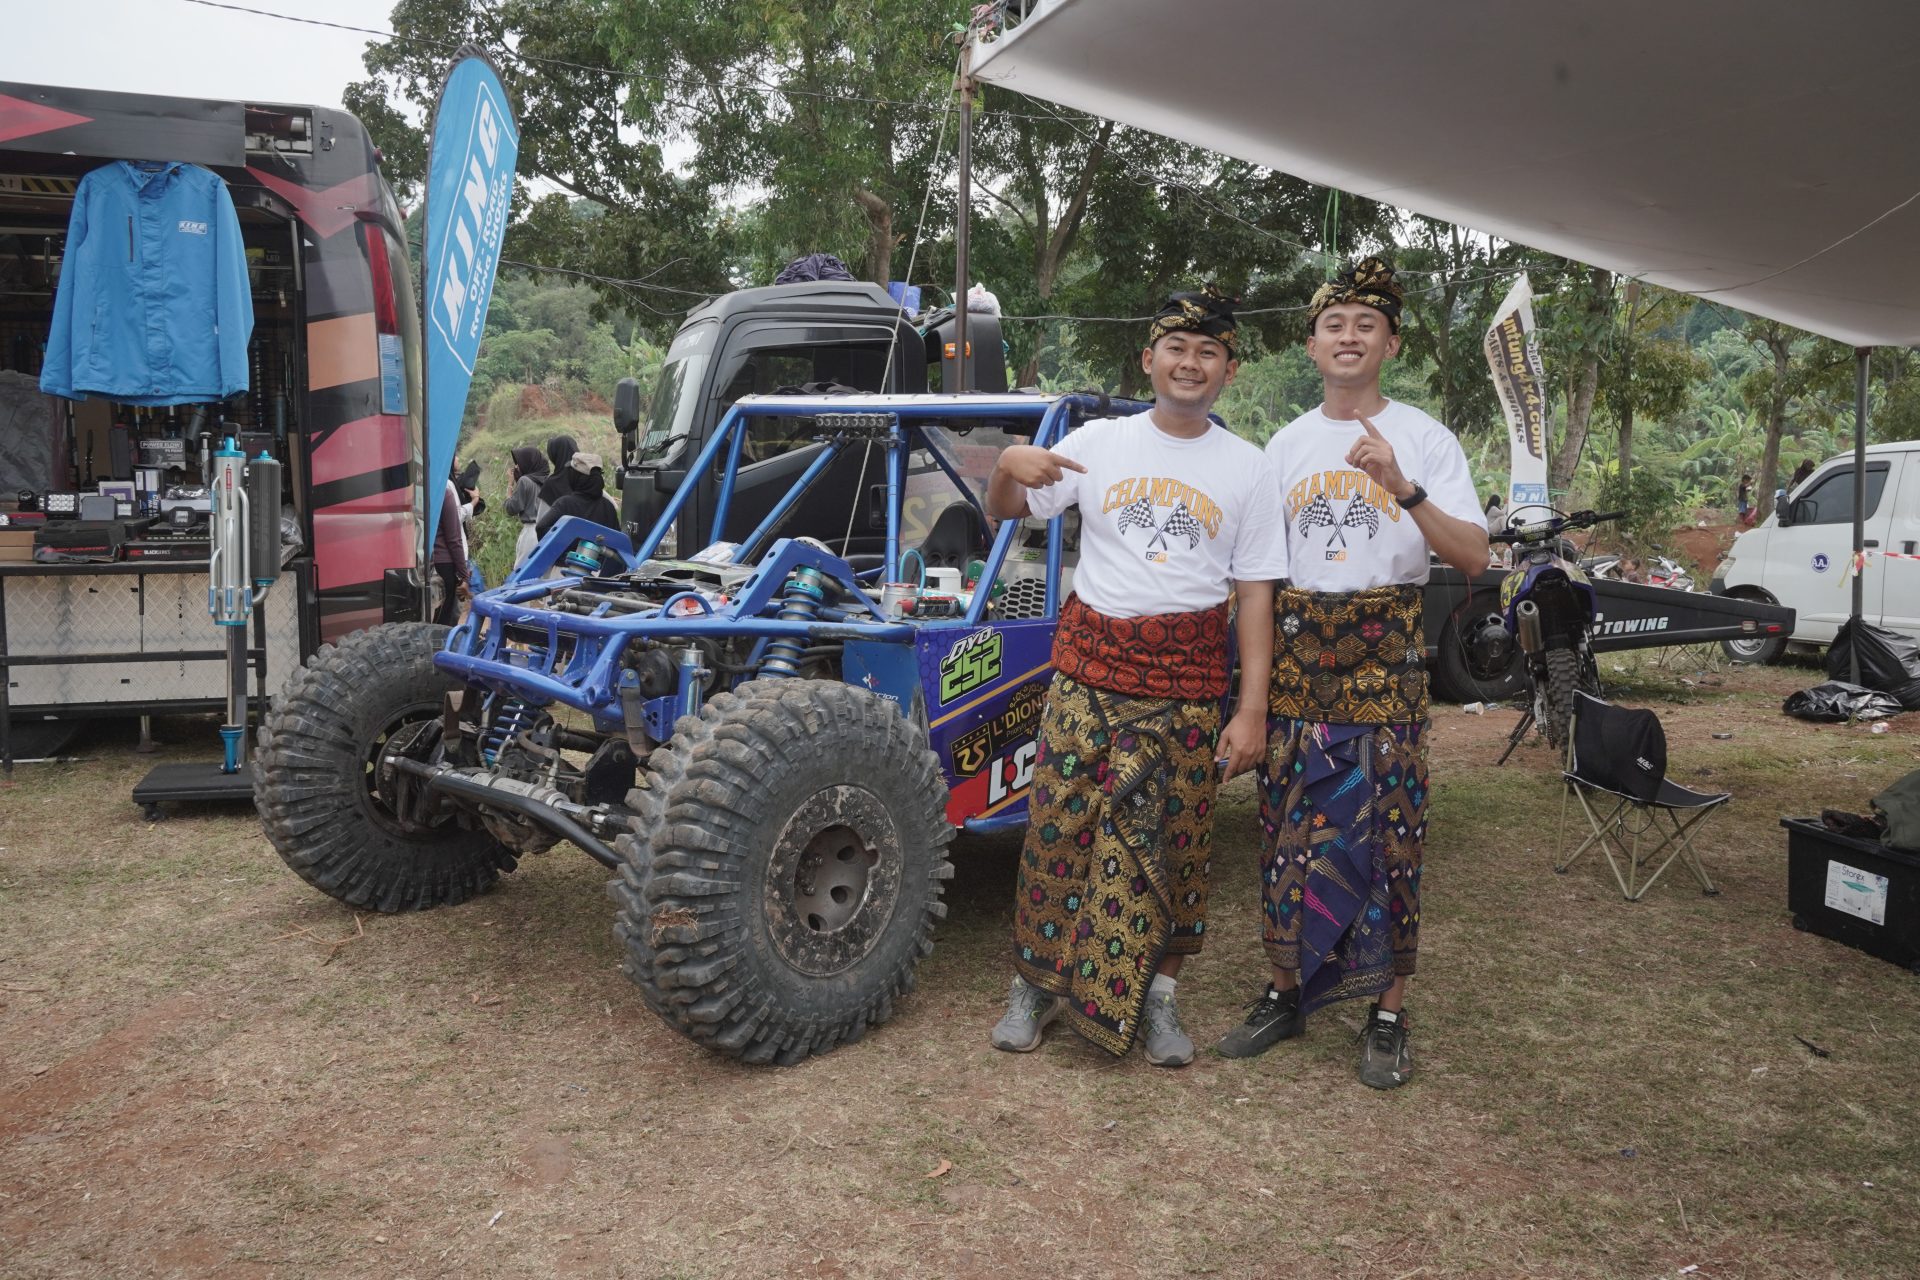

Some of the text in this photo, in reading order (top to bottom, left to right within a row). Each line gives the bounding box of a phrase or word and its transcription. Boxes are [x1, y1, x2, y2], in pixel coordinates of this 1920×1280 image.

[443, 99, 498, 338] KING
[470, 262, 484, 303] OFF
[483, 178, 499, 245] ROAD
[470, 170, 508, 339] RACING SHOCKS
[1488, 330, 1505, 369] PARTS
[1503, 386, 1525, 444] SHOCKS
[1103, 477, 1223, 540] CHAMPIONS
[1514, 492, 1546, 503] ING
[1327, 551, 1346, 560] DXR
[947, 627, 993, 666] DYO
[1604, 617, 1668, 634] TOWING
[941, 633, 1001, 702] 252
[1841, 865, 1865, 881] Storex
